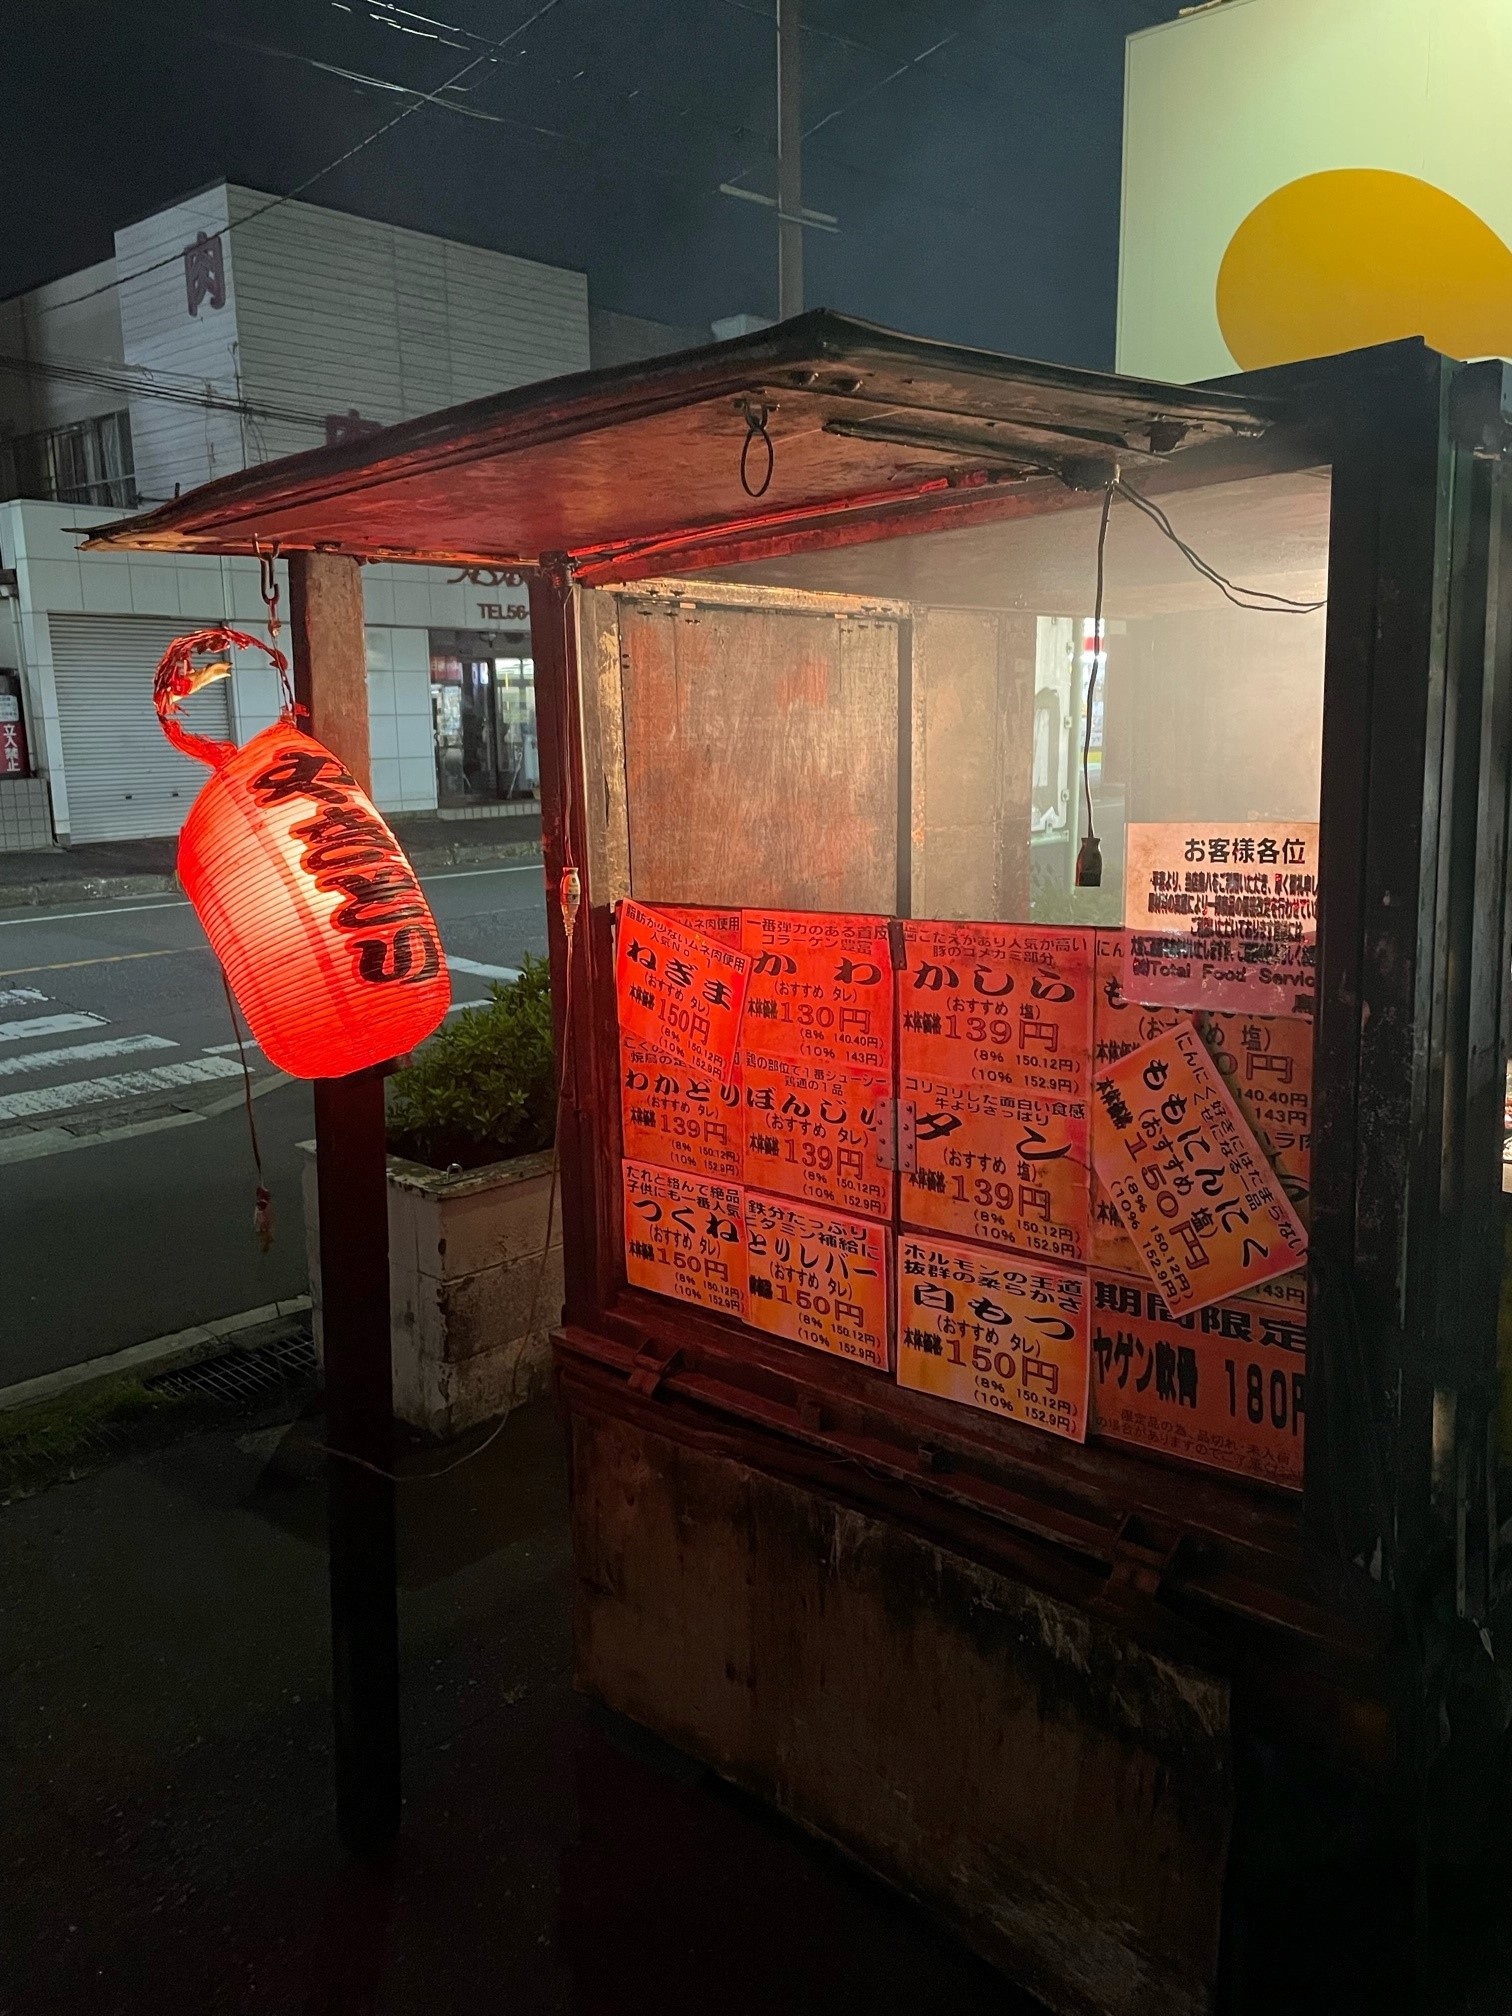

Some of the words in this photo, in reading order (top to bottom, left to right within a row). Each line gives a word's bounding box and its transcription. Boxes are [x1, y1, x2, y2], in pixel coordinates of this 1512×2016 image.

[184, 231, 226, 317] 肉
[3, 724, 21, 772] 立入禁止
[253, 751, 441, 985] やきとり
[1184, 837, 1306, 864] お客様各位
[747, 918, 888, 941] 一番弾力のある首皮
[627, 937, 732, 1011] ねぎま
[645, 972, 684, 1002] (おすすめ
[752, 950, 882, 986] かわ
[913, 960, 1076, 1003] かしら
[1202, 963, 1247, 984] Food
[774, 979, 824, 1000] (おすすめ
[833, 986, 857, 1003] タレ)
[946, 996, 1009, 1016] (おすすめ
[1020, 1002, 1041, 1021] 塩)
[658, 999, 710, 1046] 150円
[661, 1024, 681, 1043] (8%
[781, 1001, 871, 1035] 130円
[945, 1014, 1060, 1053] 139円
[800, 1027, 824, 1041] (8%
[834, 1033, 884, 1050] 140.40円)
[800, 1042, 836, 1060] (10%
[846, 1051, 884, 1067] 143円)
[659, 1036, 685, 1059] (10%
[692, 1055, 726, 1082] 152.9円)
[973, 1048, 1005, 1063] (8%
[1016, 1054, 1081, 1073] 150.12円)
[625, 1068, 740, 1107] わかどり
[906, 1077, 1086, 1120] コリコリした面白い食感
[971, 1067, 1013, 1084] (10%
[1023, 1075, 1080, 1094] 152.9円)
[647, 1095, 690, 1114] (おすすめ
[698, 1104, 719, 1120] タレ)
[936, 1097, 1050, 1126] 牛よりさっぱり
[661, 1114, 728, 1145] 139円
[766, 1112, 827, 1139] (おすすめ
[838, 1127, 869, 1148] タレ)
[916, 1112, 1072, 1161] タン
[1175, 1031, 1308, 1258] にんにく好きにはたまらない
[671, 1152, 697, 1167] (10%
[704, 1159, 740, 1176] 152.9円)
[672, 1140, 692, 1152] (8%
[700, 1146, 740, 1164] 150.12円)
[784, 1138, 864, 1181] 139円
[943, 1146, 1007, 1176] (おすすめ
[1017, 1160, 1037, 1184] 塩)
[1143, 1059, 1269, 1268] ももにんにく
[1193, 1092, 1263, 1211] くせになる一品
[627, 1165, 740, 1204] たれと絡んで絶品
[803, 1169, 828, 1184] (8%
[836, 1177, 887, 1198] 150.12円)
[1138, 1108, 1195, 1196] (おすすめ
[1190, 1207, 1219, 1239] 塩)
[627, 1179, 740, 1219] 子供にも一番人気
[803, 1183, 835, 1201] (10%
[843, 1194, 887, 1214] 152.9円)
[951, 1175, 1051, 1222] 139円
[1124, 1132, 1210, 1270] 150円
[632, 1200, 739, 1243] つくね
[748, 1199, 868, 1241] 鉄分たっぷり
[974, 1209, 1005, 1226] (8%
[1017, 1219, 1081, 1243] 150.12円)
[1123, 1175, 1149, 1214] (8%
[1150, 1224, 1194, 1300] 150.12円)
[650, 1224, 692, 1251] (おすすめ
[700, 1236, 720, 1259] タレ)
[747, 1229, 878, 1280] とりレバー
[974, 1223, 1016, 1244] (10%
[1026, 1236, 1082, 1260] 152.9円)
[1110, 1180, 1140, 1230] (10%
[1142, 1241, 1182, 1306] 152.9円)
[657, 1247, 728, 1282] 150円
[675, 1271, 696, 1286] (8%
[770, 1261, 819, 1290] (おすすめ
[828, 1278, 853, 1301] タレ)
[904, 1243, 1083, 1297] ホルモンの王道
[674, 1284, 702, 1300] (10%
[904, 1259, 1082, 1314] 抜群の柔らかさ
[776, 1284, 864, 1329] 150円
[914, 1281, 1075, 1341] 白もつ
[1095, 1281, 1307, 1354] 期間限定
[798, 1327, 830, 1348] (10%
[839, 1341, 881, 1365] 152.9円)
[799, 1313, 823, 1329] (8%
[831, 1323, 881, 1348] 150.12円)
[937, 1314, 1000, 1346] (おすすめ
[1010, 1334, 1041, 1359] タレ)
[946, 1339, 1060, 1395] 150円
[974, 1390, 1014, 1413] (10%
[1025, 1407, 1077, 1434] 152.9円)
[975, 1375, 1005, 1394] (8%
[1017, 1388, 1078, 1416] 150.12円)
